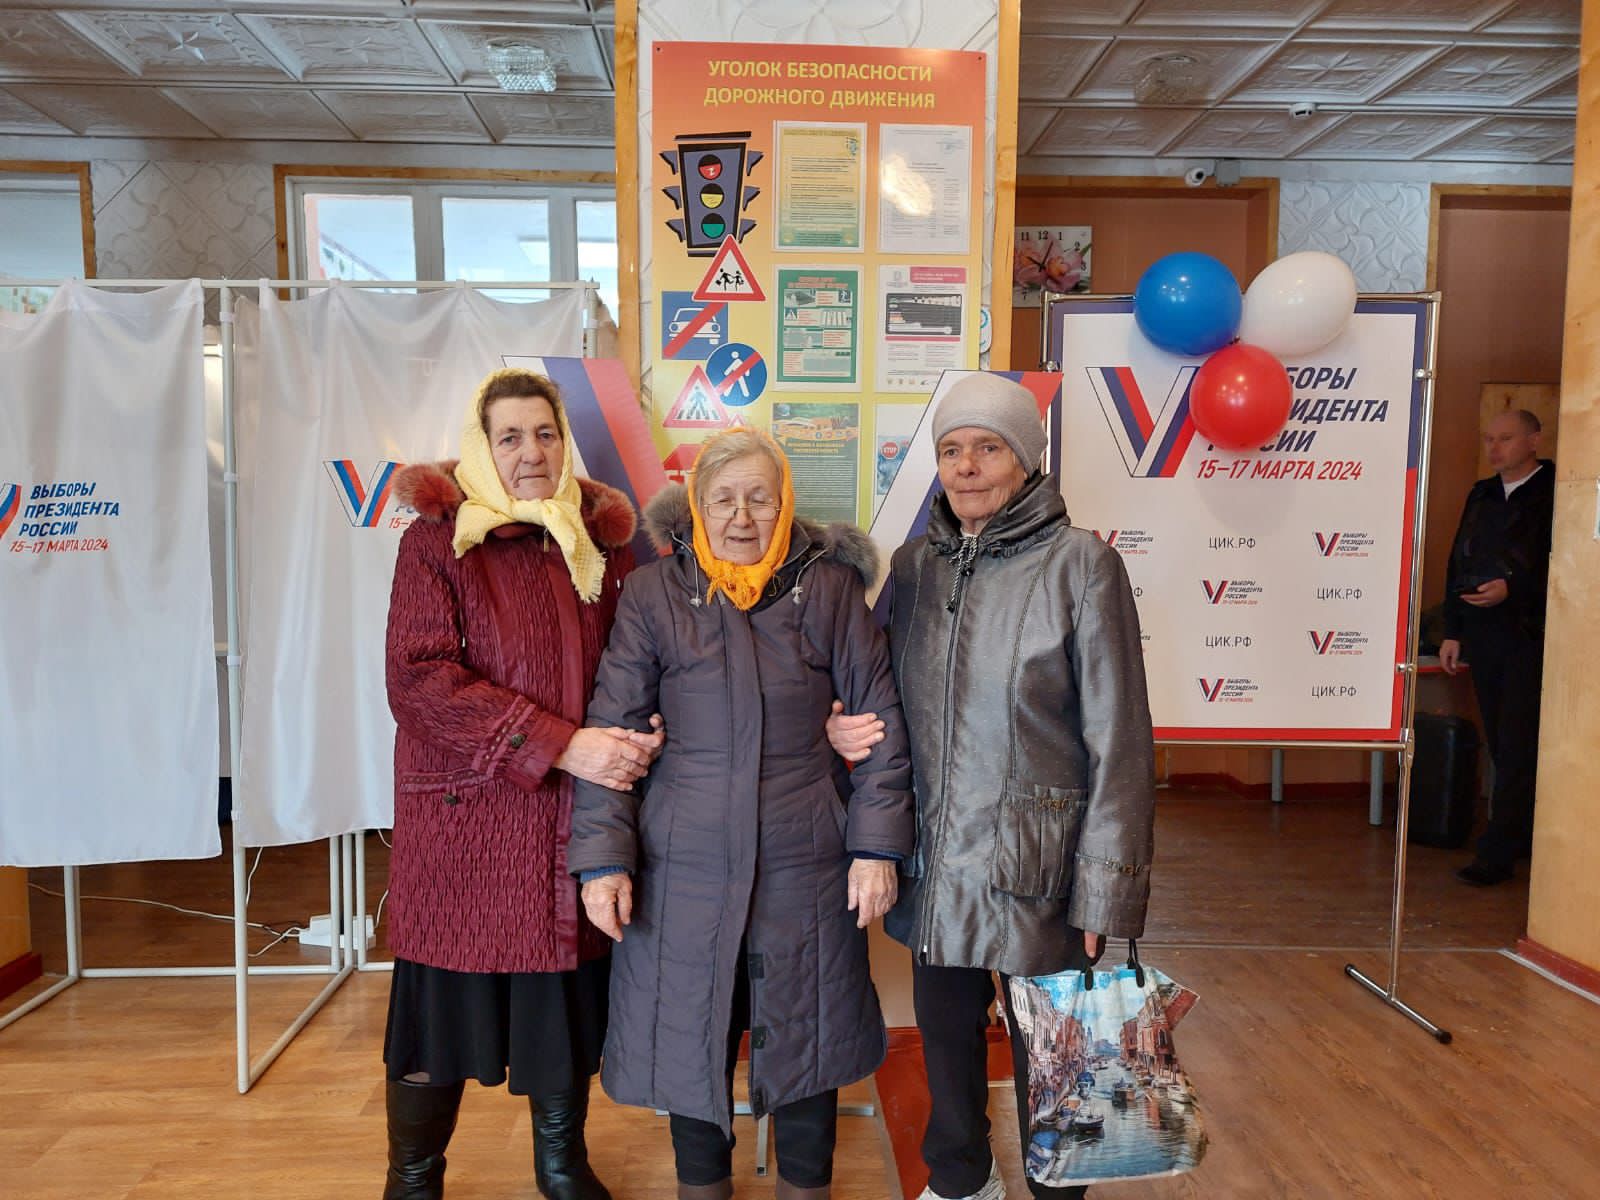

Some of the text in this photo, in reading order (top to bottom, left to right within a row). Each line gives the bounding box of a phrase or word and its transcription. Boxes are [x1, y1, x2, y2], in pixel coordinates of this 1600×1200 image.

[708, 60, 932, 82] УГОЛОК БЕЗОПАСНОСТИ
[703, 87, 936, 110] ДОРОЖНОГО ДВИЖЕНИЯ
[1021, 231, 1030, 241] 11
[1038, 230, 1049, 240] 12
[1286, 366, 1358, 390] БОРЫ
[1288, 398, 1389, 424] ИДЕНТА
[1250, 459, 1315, 480] МАРТА
[1317, 460, 1363, 481] 2024
[30, 482, 97, 500] ВЫБОРЫ
[24, 501, 120, 518] ПРЕЗИДЕНТА
[19, 521, 78, 537] РОССИИ
[46, 539, 80, 553] МАРТА
[80, 538, 109, 551] 2024
[1209, 536, 1256, 549] ЦИК.РФ
[1317, 588, 1362, 600] ЦИК.РФ
[1206, 636, 1252, 648] ЦИК.РФ
[1312, 686, 1357, 698] ЦИК.РФ
